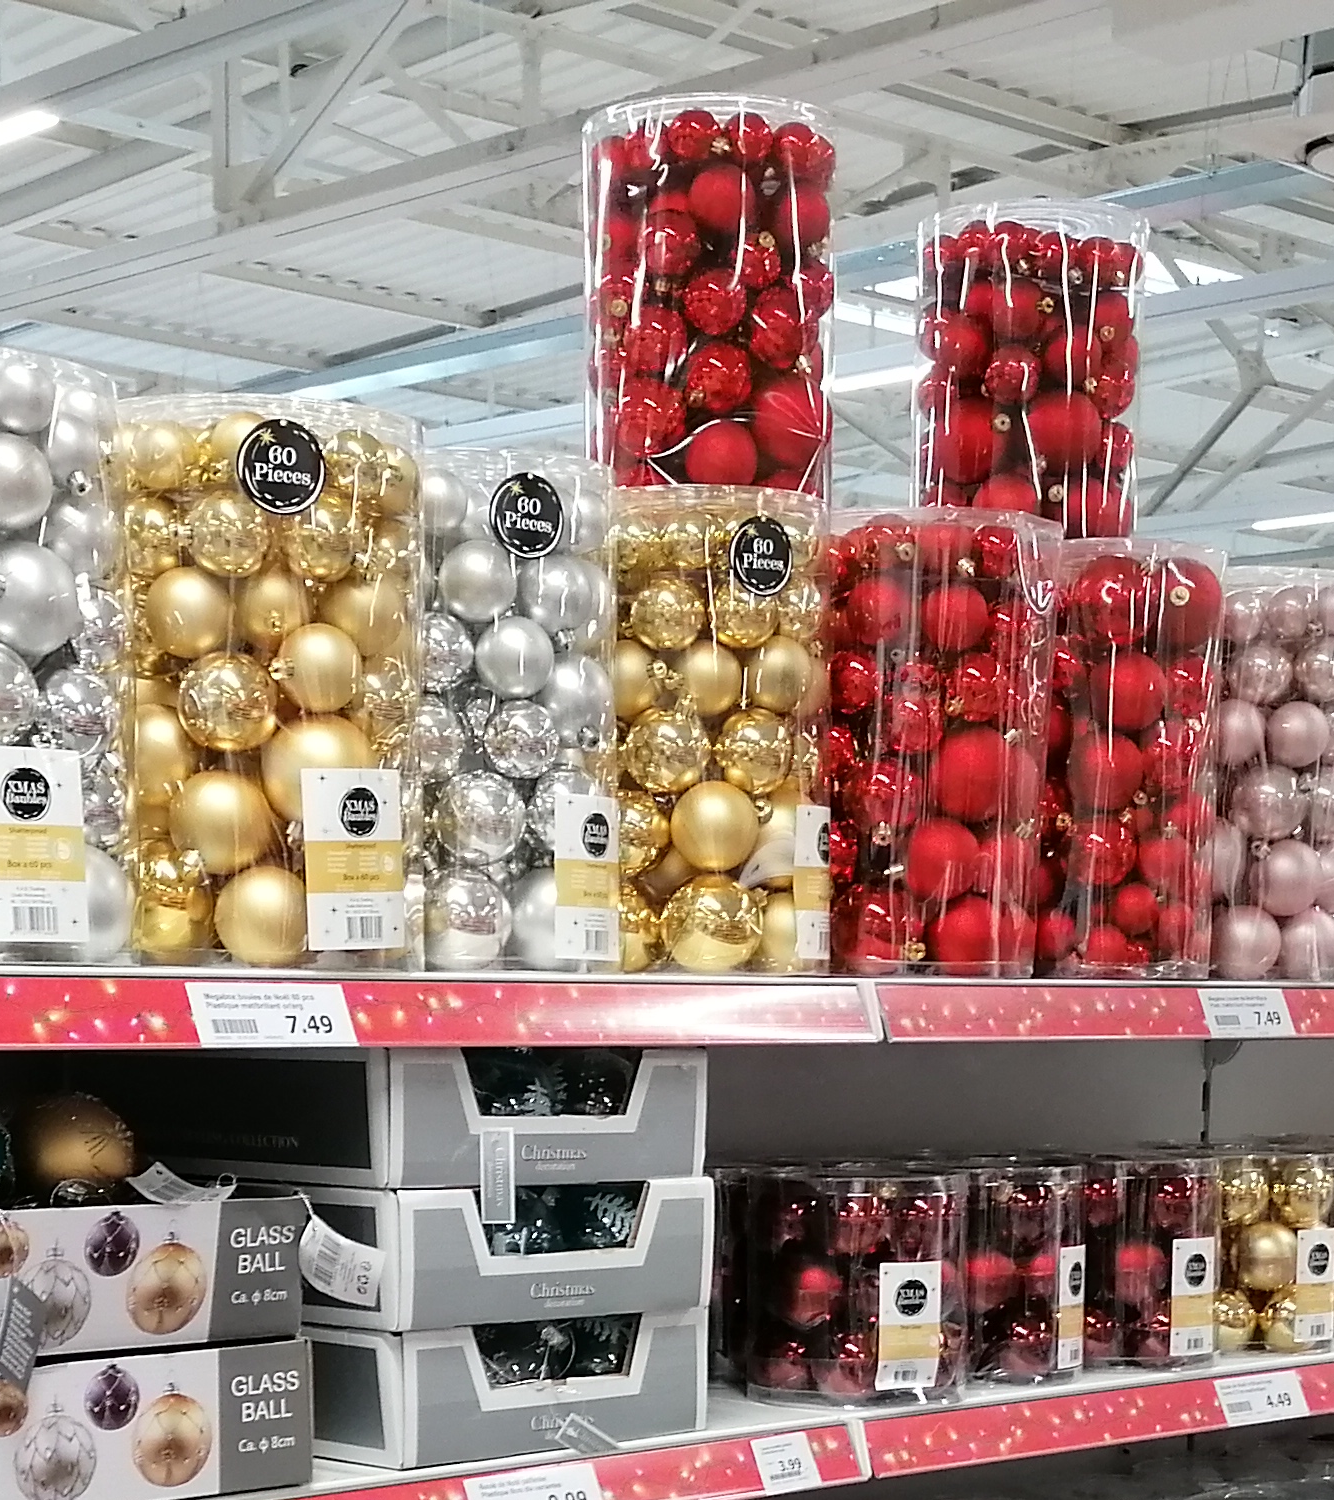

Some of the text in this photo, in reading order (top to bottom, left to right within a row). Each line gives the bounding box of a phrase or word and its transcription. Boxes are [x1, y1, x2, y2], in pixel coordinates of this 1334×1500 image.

[268, 445, 297, 465] 60
[253, 463, 312, 487] Pieces
[517, 496, 542, 516] 60
[504, 513, 553, 534] Pieces
[753, 540, 774, 557] 60
[741, 553, 784, 572] Pieces
[7, 780, 46, 794] XMAS
[346, 799, 375, 811] XMAS
[284, 1015, 333, 1034] 7.49
[1254, 1011, 1281, 1026] 7.49
[521, 1144, 588, 1162] Christmas
[230, 1225, 296, 1248] GLASS
[238, 1252, 286, 1274] BALL
[264, 1289, 287, 1301] 8cm
[530, 1282, 595, 1300] Christmas
[231, 1370, 300, 1397] GLASS
[1266, 1392, 1291, 1408] 4.49
[242, 1399, 293, 1422] BALL
[271, 1436, 296, 1449] 8cm
[778, 1457, 802, 1472] 3.99
